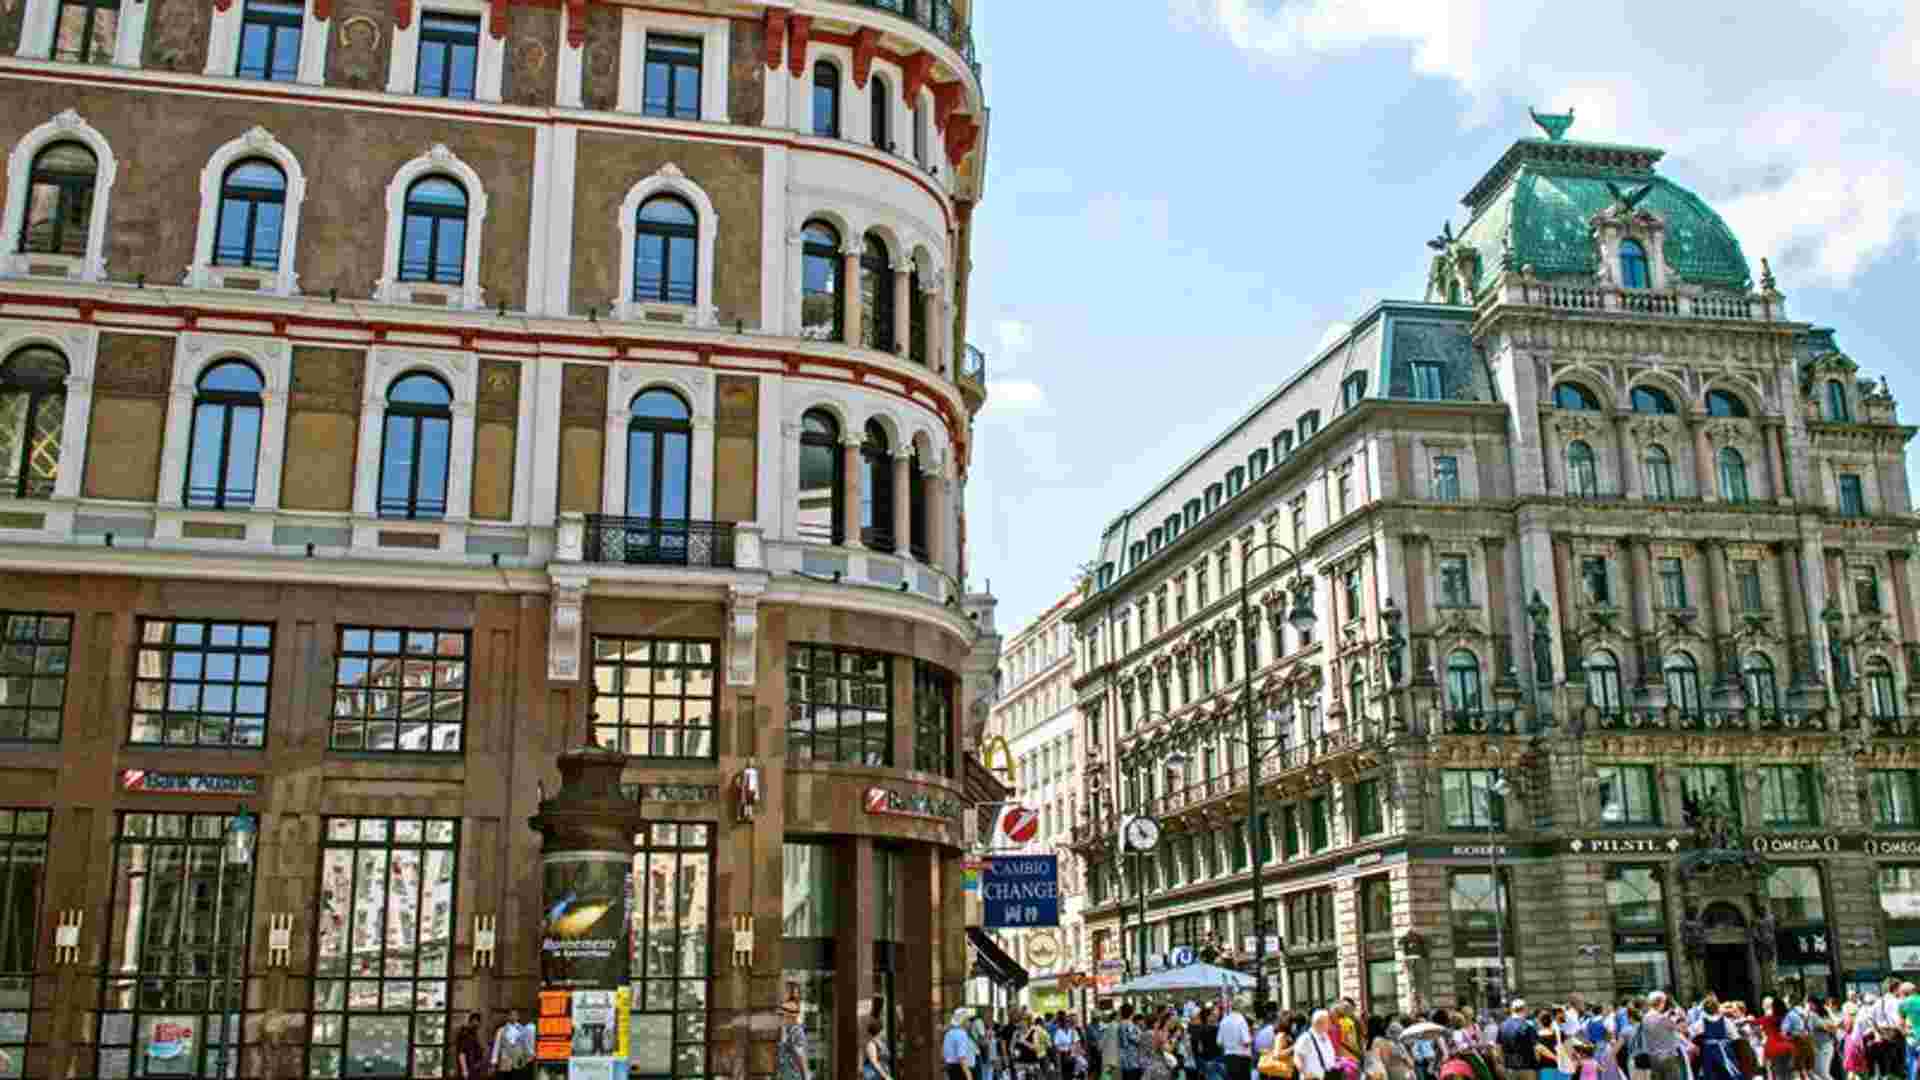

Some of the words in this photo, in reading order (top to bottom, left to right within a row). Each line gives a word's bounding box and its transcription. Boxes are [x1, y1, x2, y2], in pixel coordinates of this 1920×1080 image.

[1771, 839, 1820, 851] OMEGA
[991, 861, 1050, 875] CAMBIO
[984, 881, 1056, 899] CHANGE
